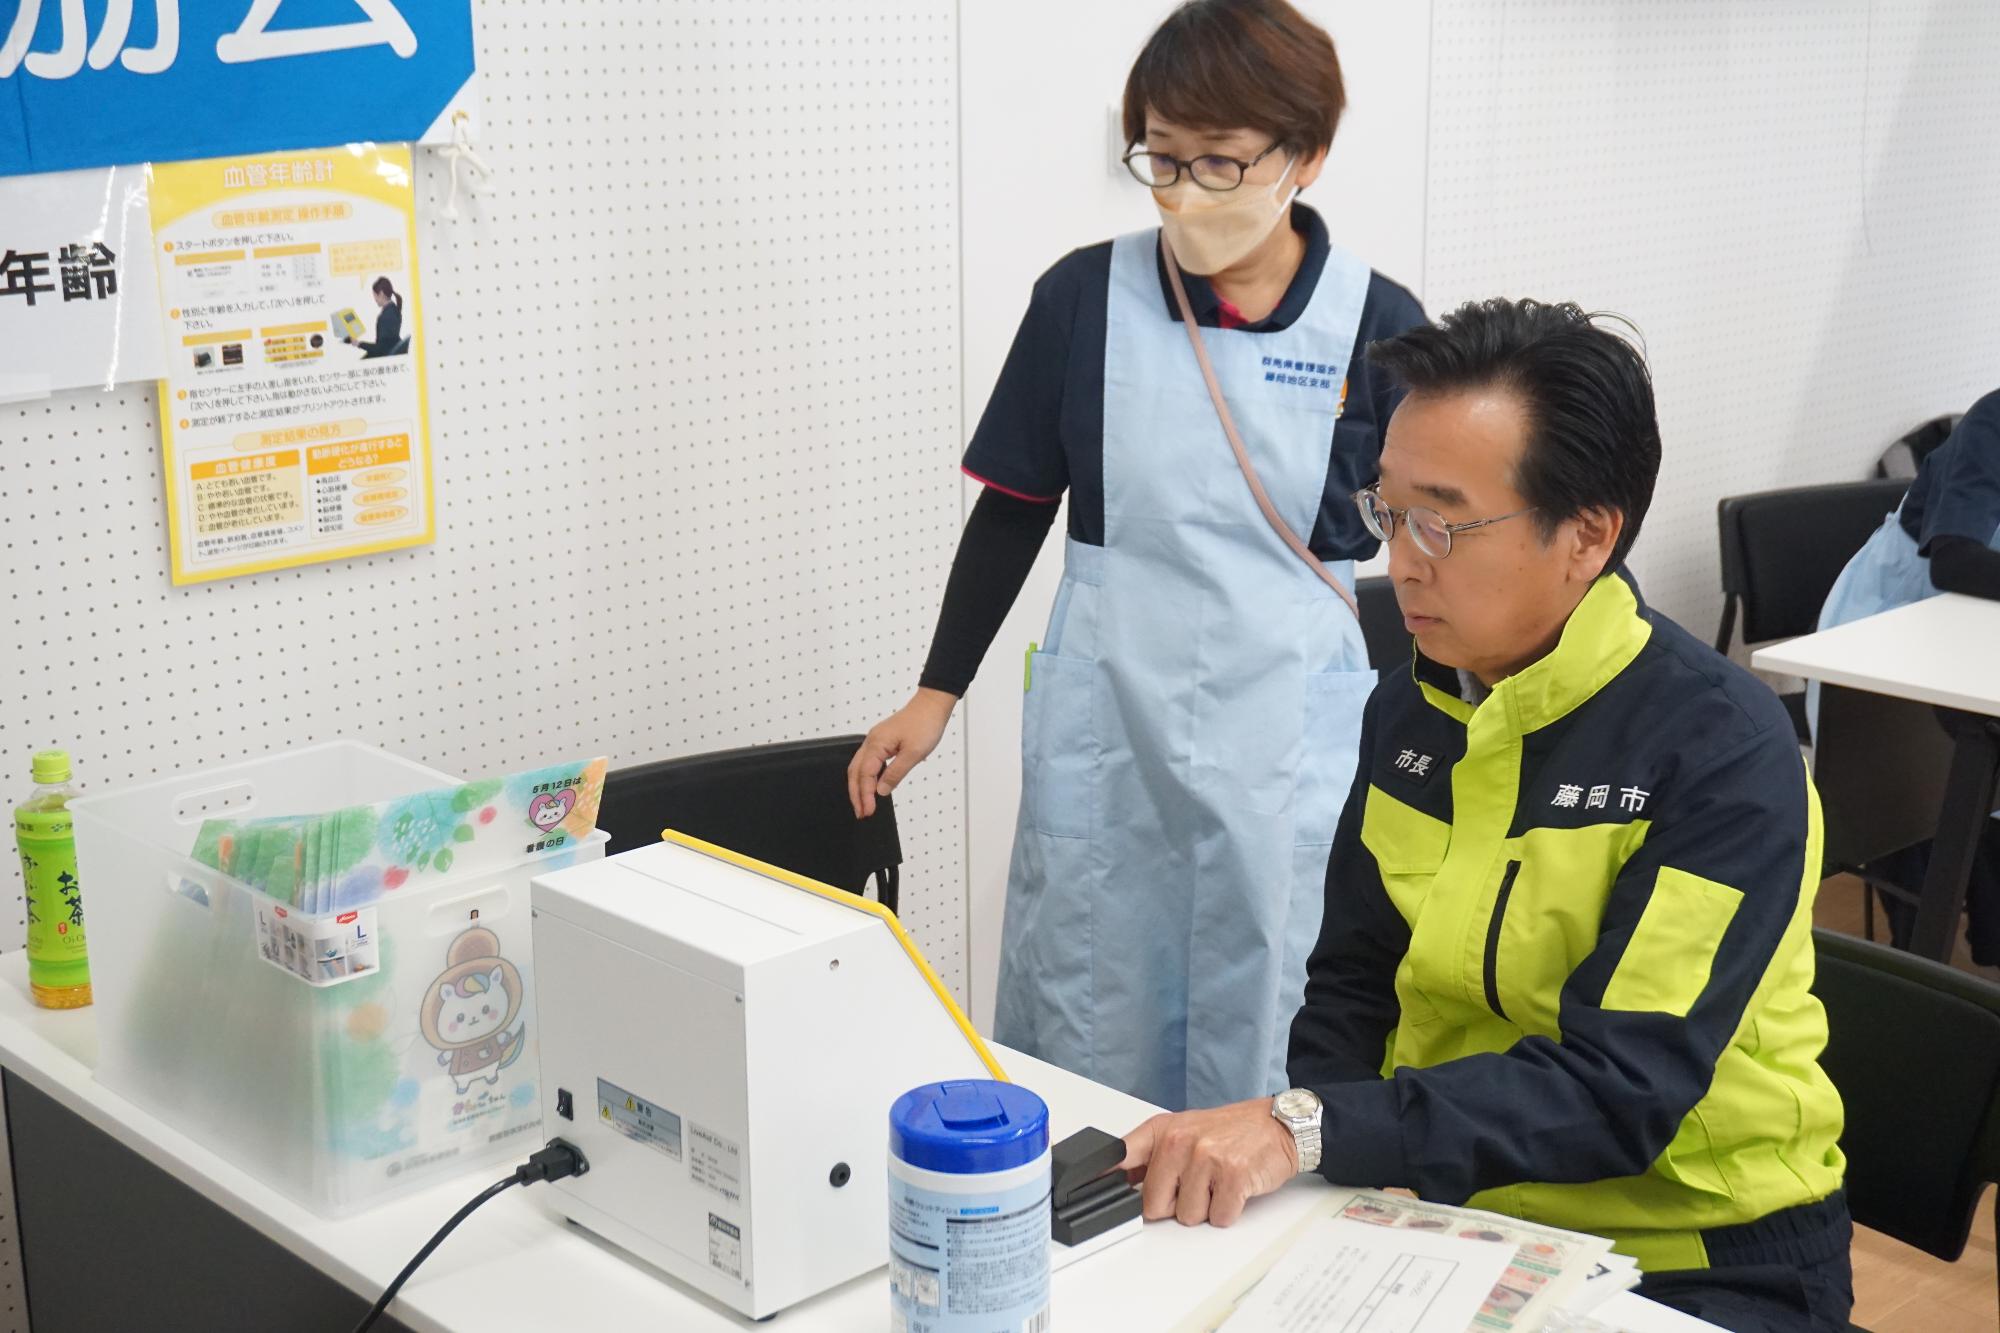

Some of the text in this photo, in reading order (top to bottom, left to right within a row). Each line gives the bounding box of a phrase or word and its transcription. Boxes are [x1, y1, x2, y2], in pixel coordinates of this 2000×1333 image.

[223, 160, 335, 188] 血管年齢計
[0, 243, 118, 307] 年齢
[1262, 356, 1337, 375] 群馬県看護協会
[1395, 749, 1433, 776] 市長
[532, 776, 582, 794] 5月12日は
[1550, 783, 1650, 812] 藤岡市
[526, 836, 565, 853] 看護の日
[357, 924, 367, 939] L
